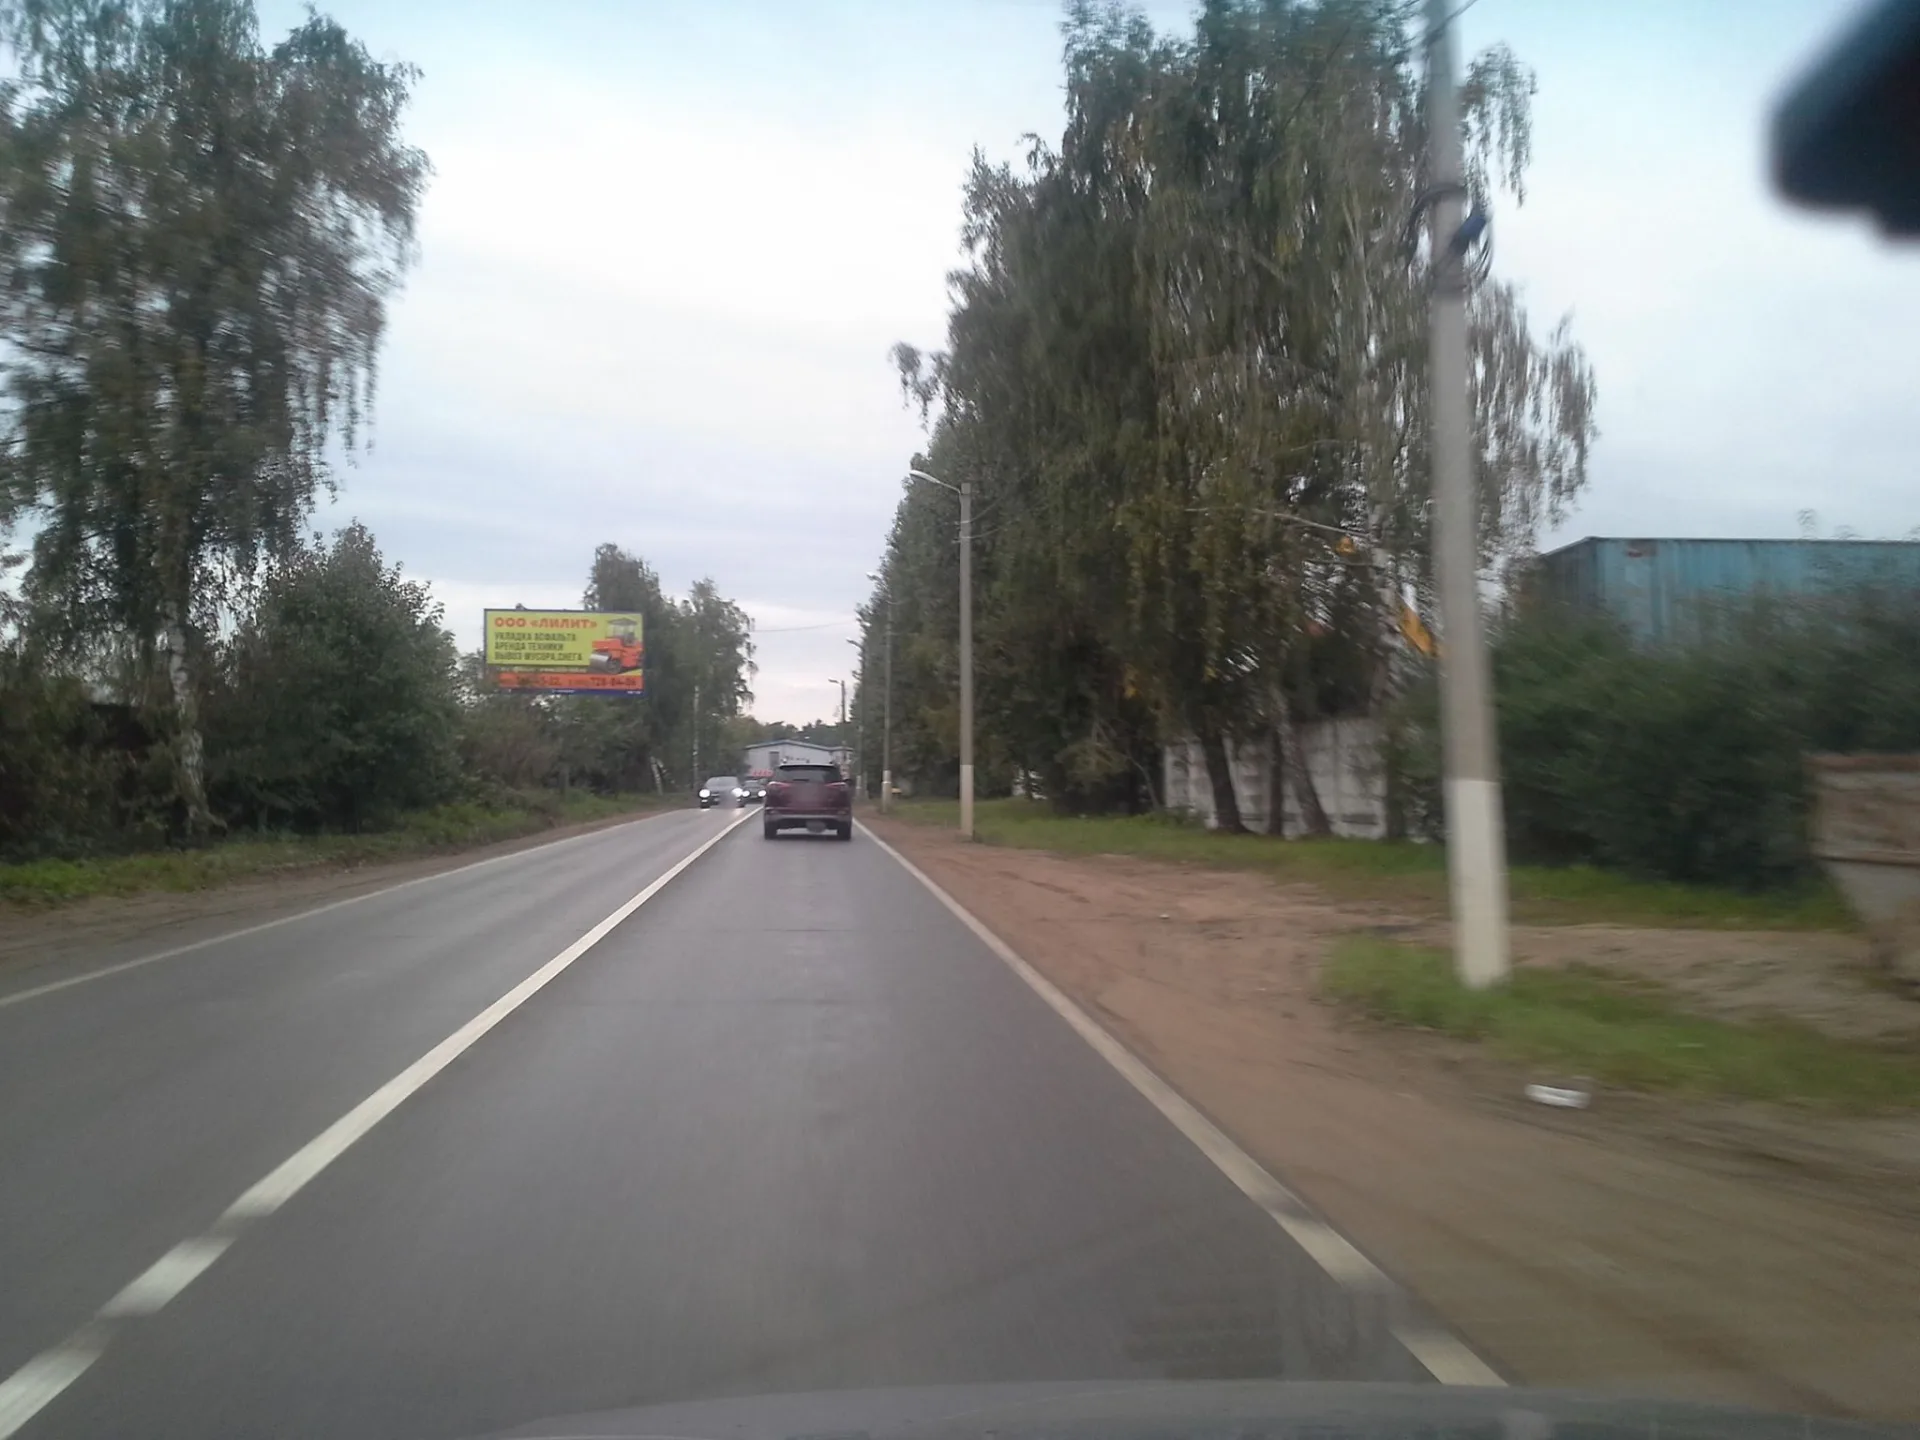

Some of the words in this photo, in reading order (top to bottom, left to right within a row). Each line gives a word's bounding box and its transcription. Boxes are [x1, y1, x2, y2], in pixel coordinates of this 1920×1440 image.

[495, 617, 527, 628] ООО
[530, 617, 598, 629] «ЛИЛИТ»
[495, 632, 532, 641] УКЛАДКА
[534, 632, 577, 641] АСФАЛЬТА
[495, 642, 526, 651] АРЕНДА
[528, 642, 564, 651] ТЕХНИКИ
